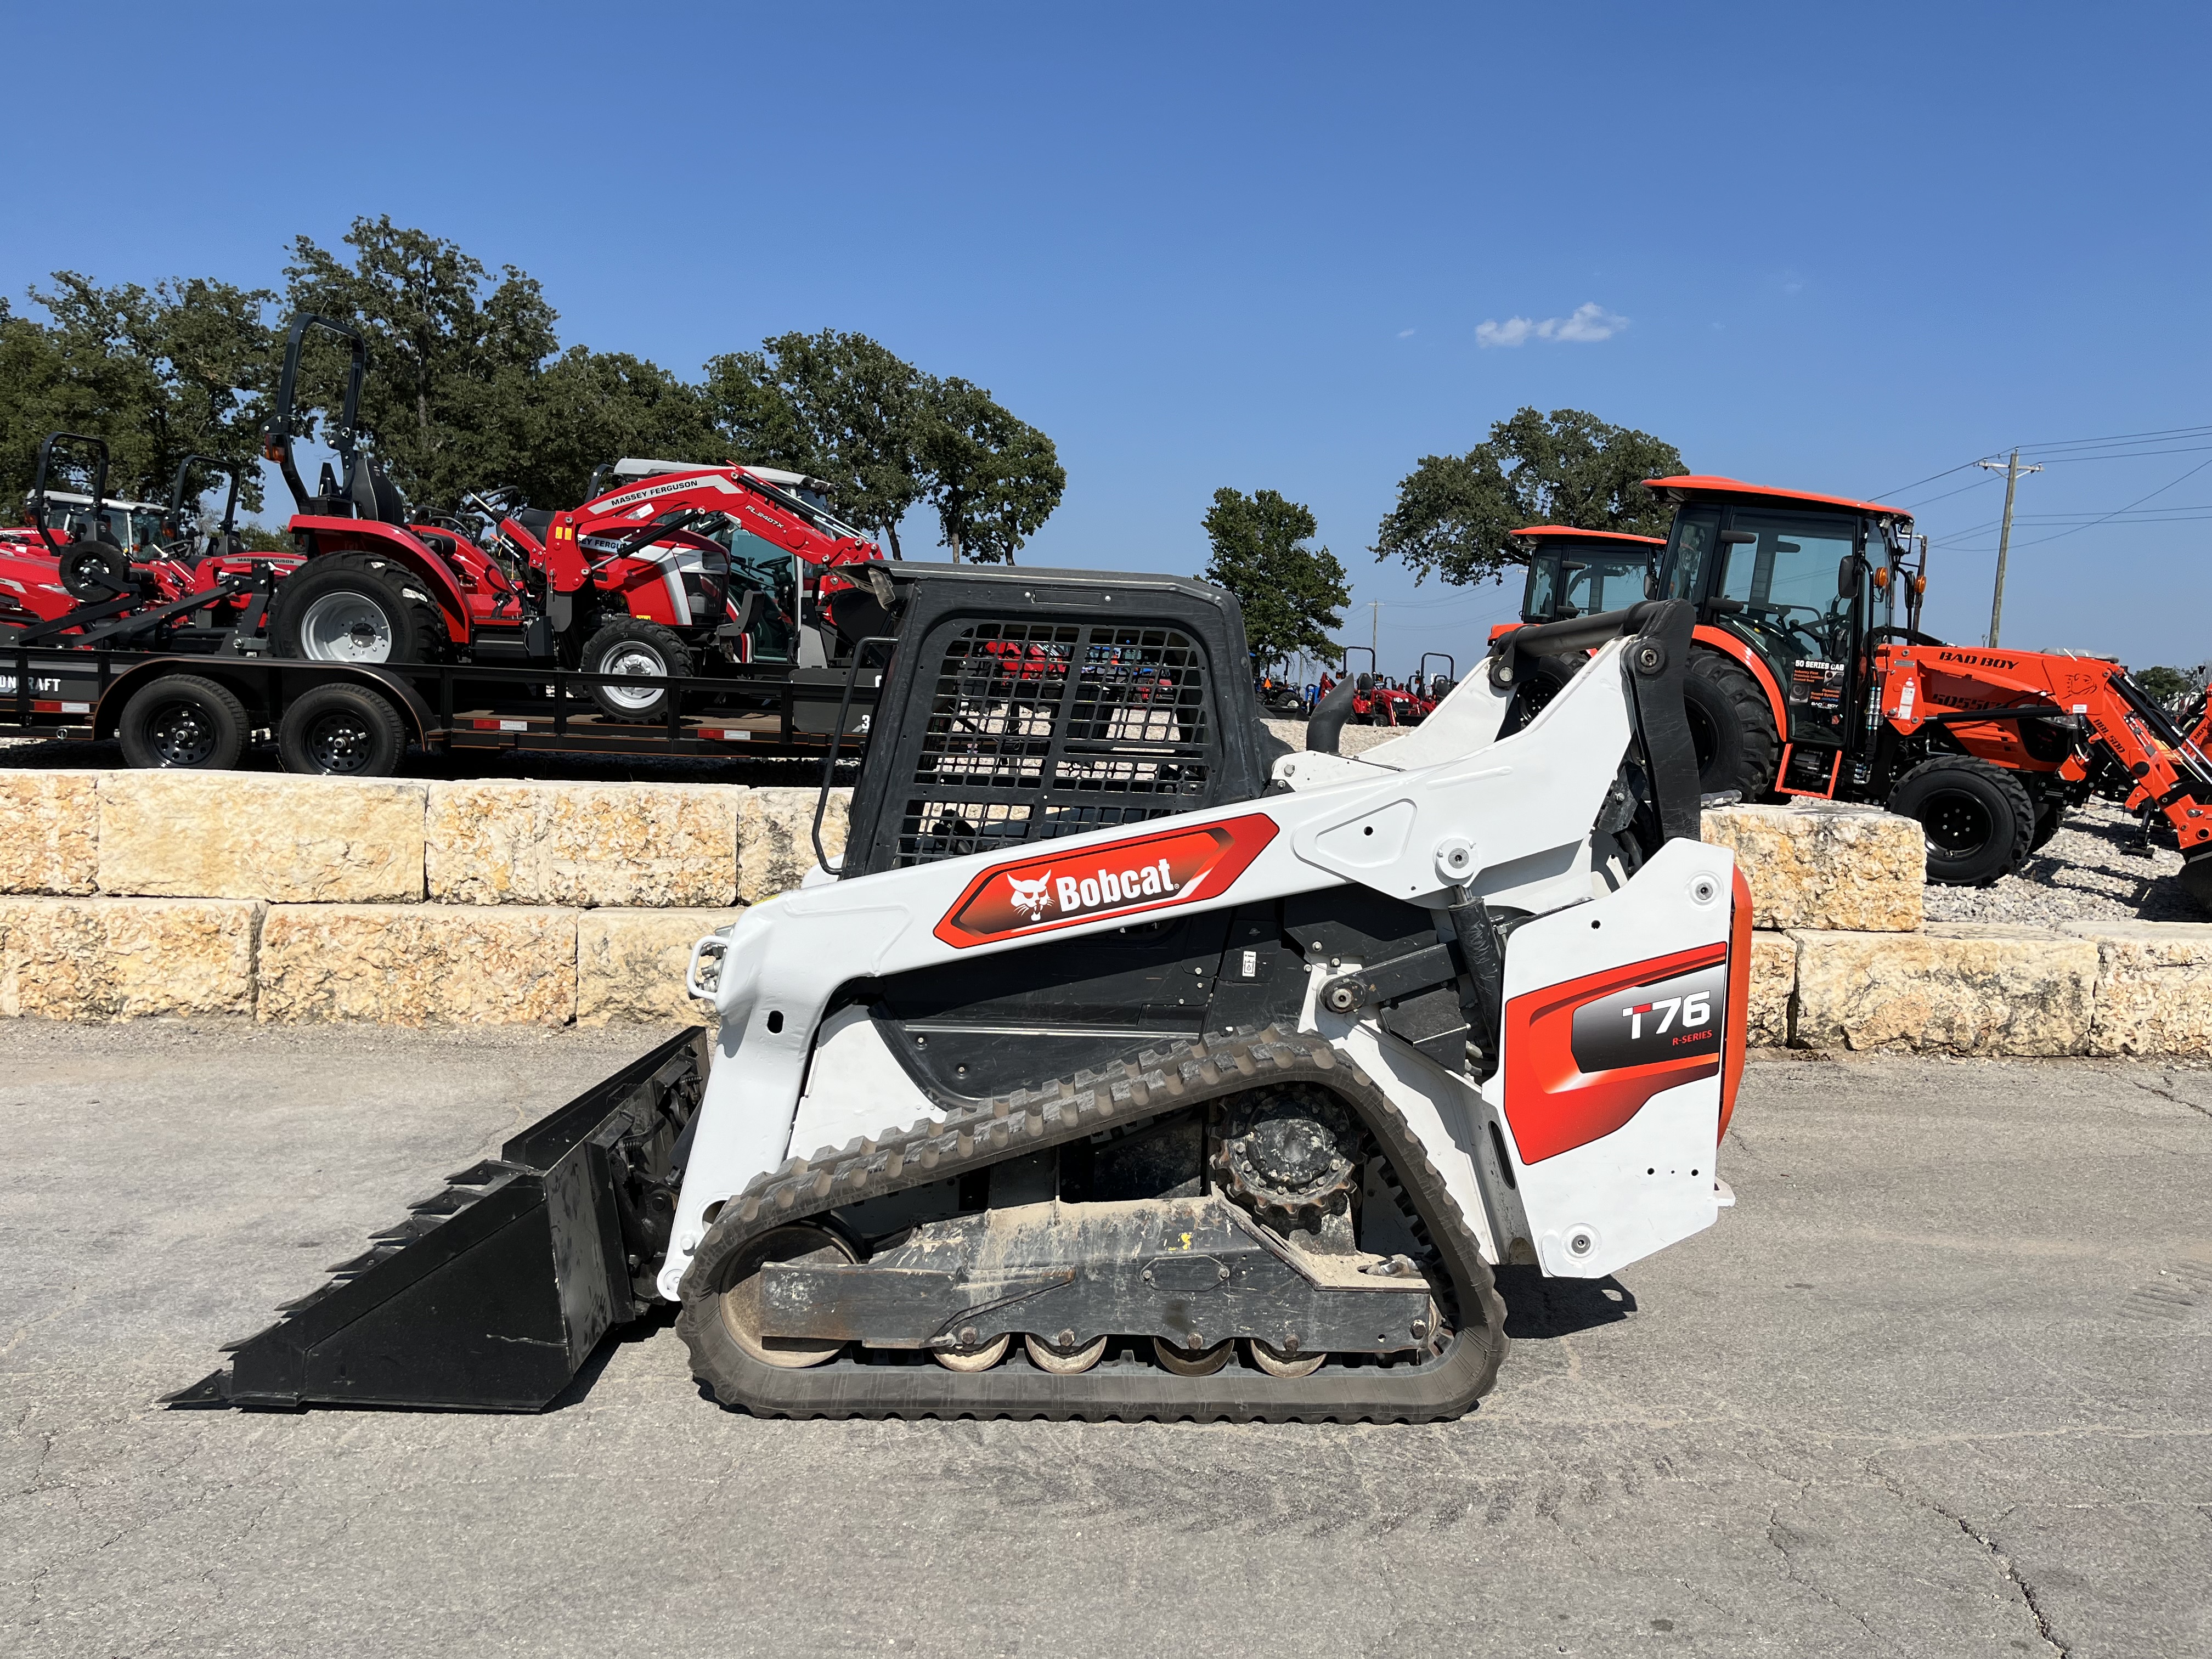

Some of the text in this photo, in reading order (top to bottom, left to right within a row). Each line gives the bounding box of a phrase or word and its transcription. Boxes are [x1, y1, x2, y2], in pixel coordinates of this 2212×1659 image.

[611, 480, 698, 506] MASSEY FERGUSON
[1805, 661, 1830, 670] SERIES
[1939, 651, 2019, 670] BAD BOY
[1056, 858, 1174, 912] Bobcat
[1622, 990, 1711, 1040] T76
[1672, 1029, 1713, 1046] R-SERIES
